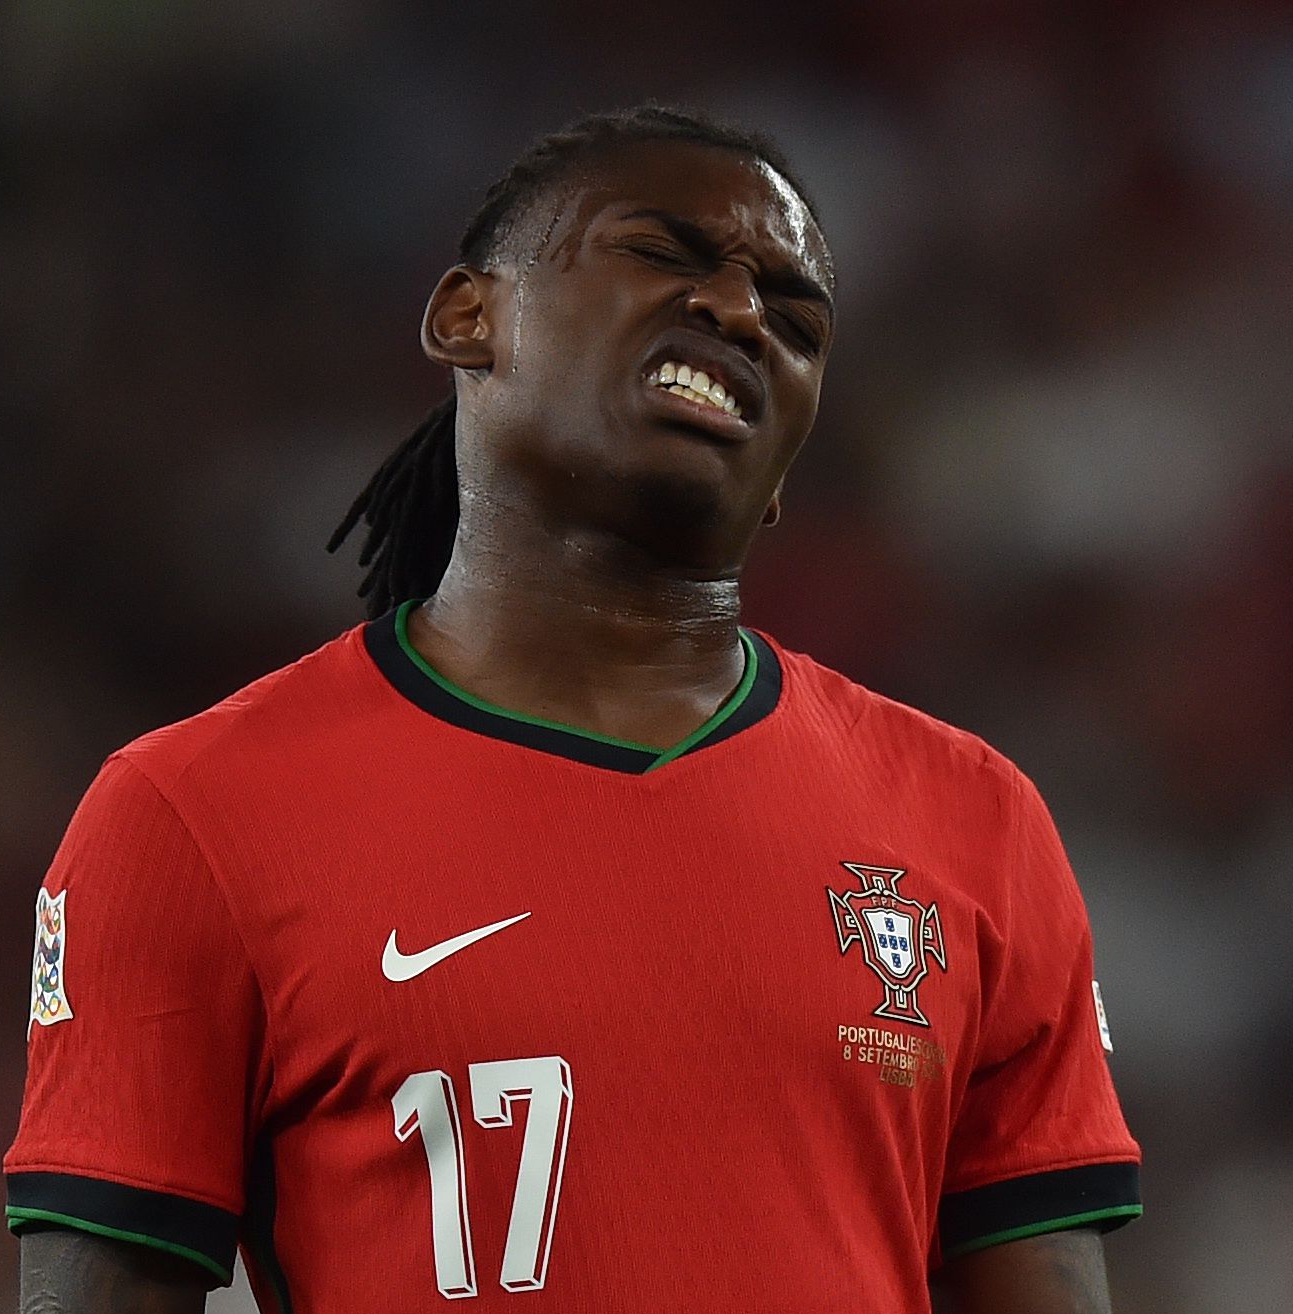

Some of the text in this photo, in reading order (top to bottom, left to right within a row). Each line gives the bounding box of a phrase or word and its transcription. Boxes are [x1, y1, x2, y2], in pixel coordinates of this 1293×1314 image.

[843, 1044, 852, 1061] 8
[879, 1065, 916, 1089] LISBO
[391, 1056, 574, 1300] 17
